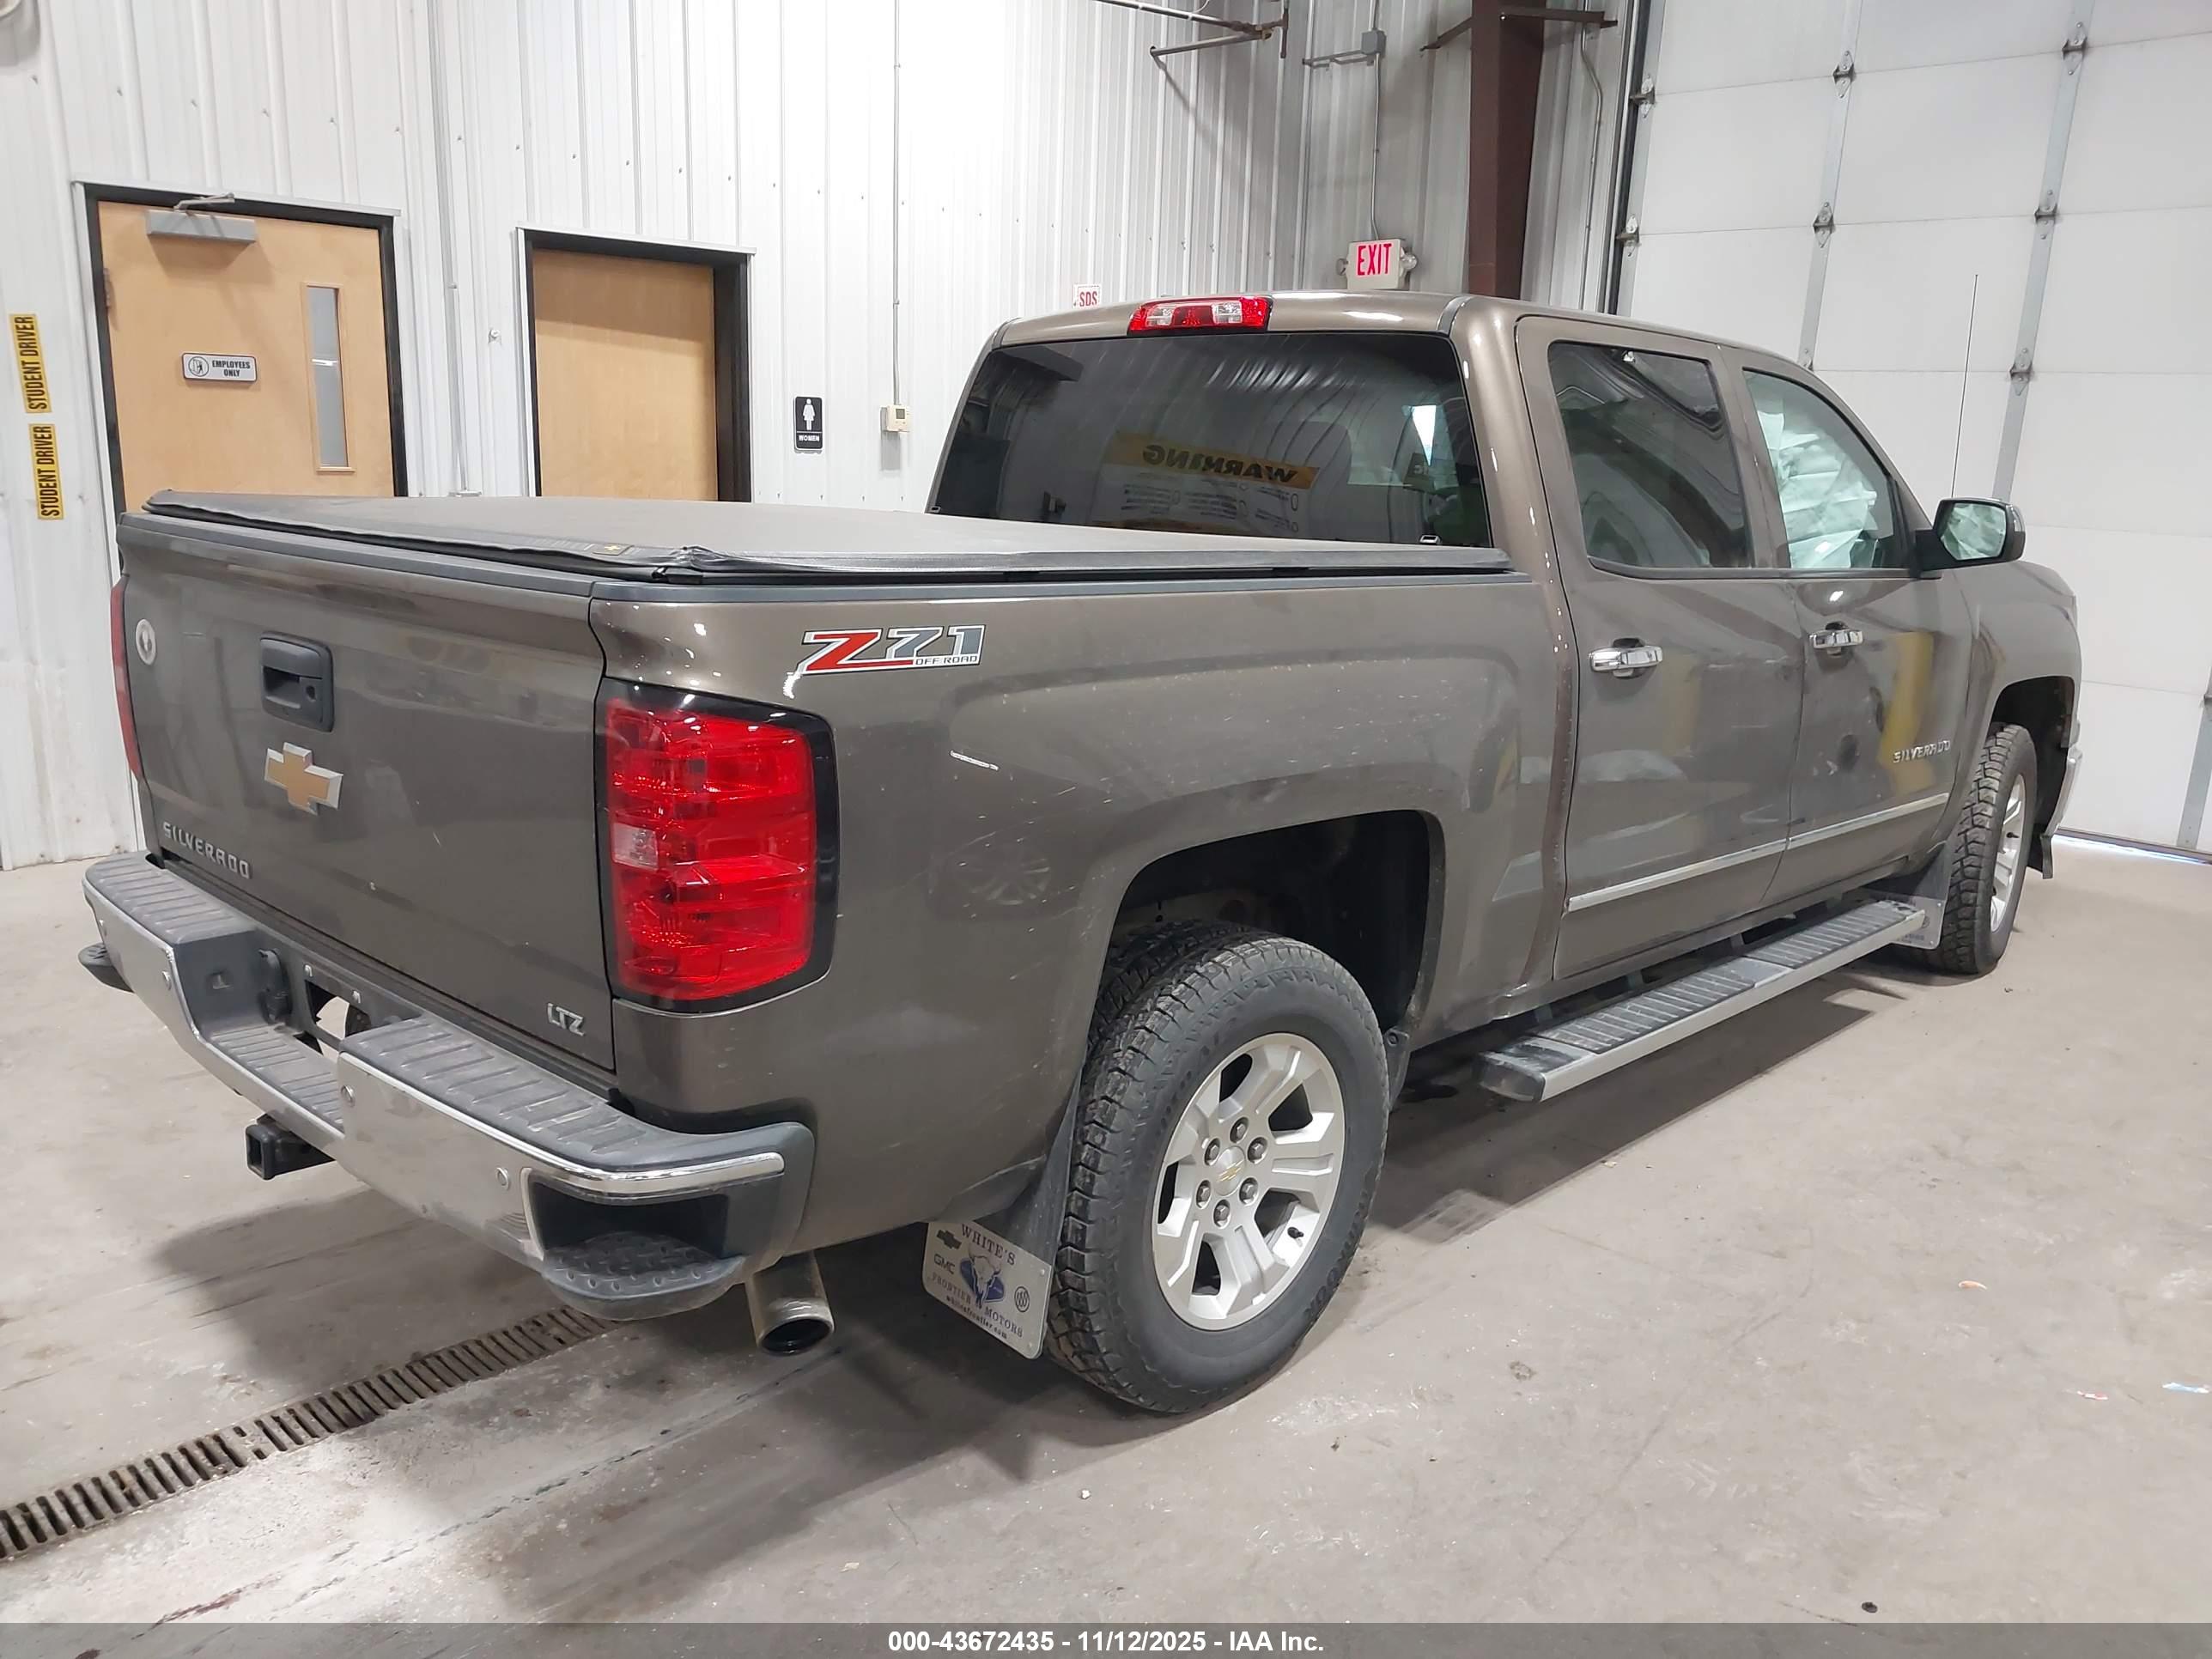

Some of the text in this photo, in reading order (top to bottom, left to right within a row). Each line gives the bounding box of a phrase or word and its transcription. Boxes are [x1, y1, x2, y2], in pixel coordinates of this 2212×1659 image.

[1357, 243, 1392, 276] EXIT
[1079, 290, 1097, 307] SDS
[15, 316, 47, 410] STUDENT DRIVER
[212, 360, 251, 369] EMPLOYEES
[33, 426, 60, 517] STUDENT DRIVER
[796, 624, 986, 675] Z71
[915, 655, 977, 665] OFF ROAD
[1893, 740, 1951, 763] SILVERADO
[163, 821, 251, 879] SILVERADO
[548, 1002, 584, 1036] LTZ
[961, 1224, 1015, 1266] WHITE'S
[934, 1254, 955, 1274] GMC
[984, 1306, 1023, 1338] MOTORS
